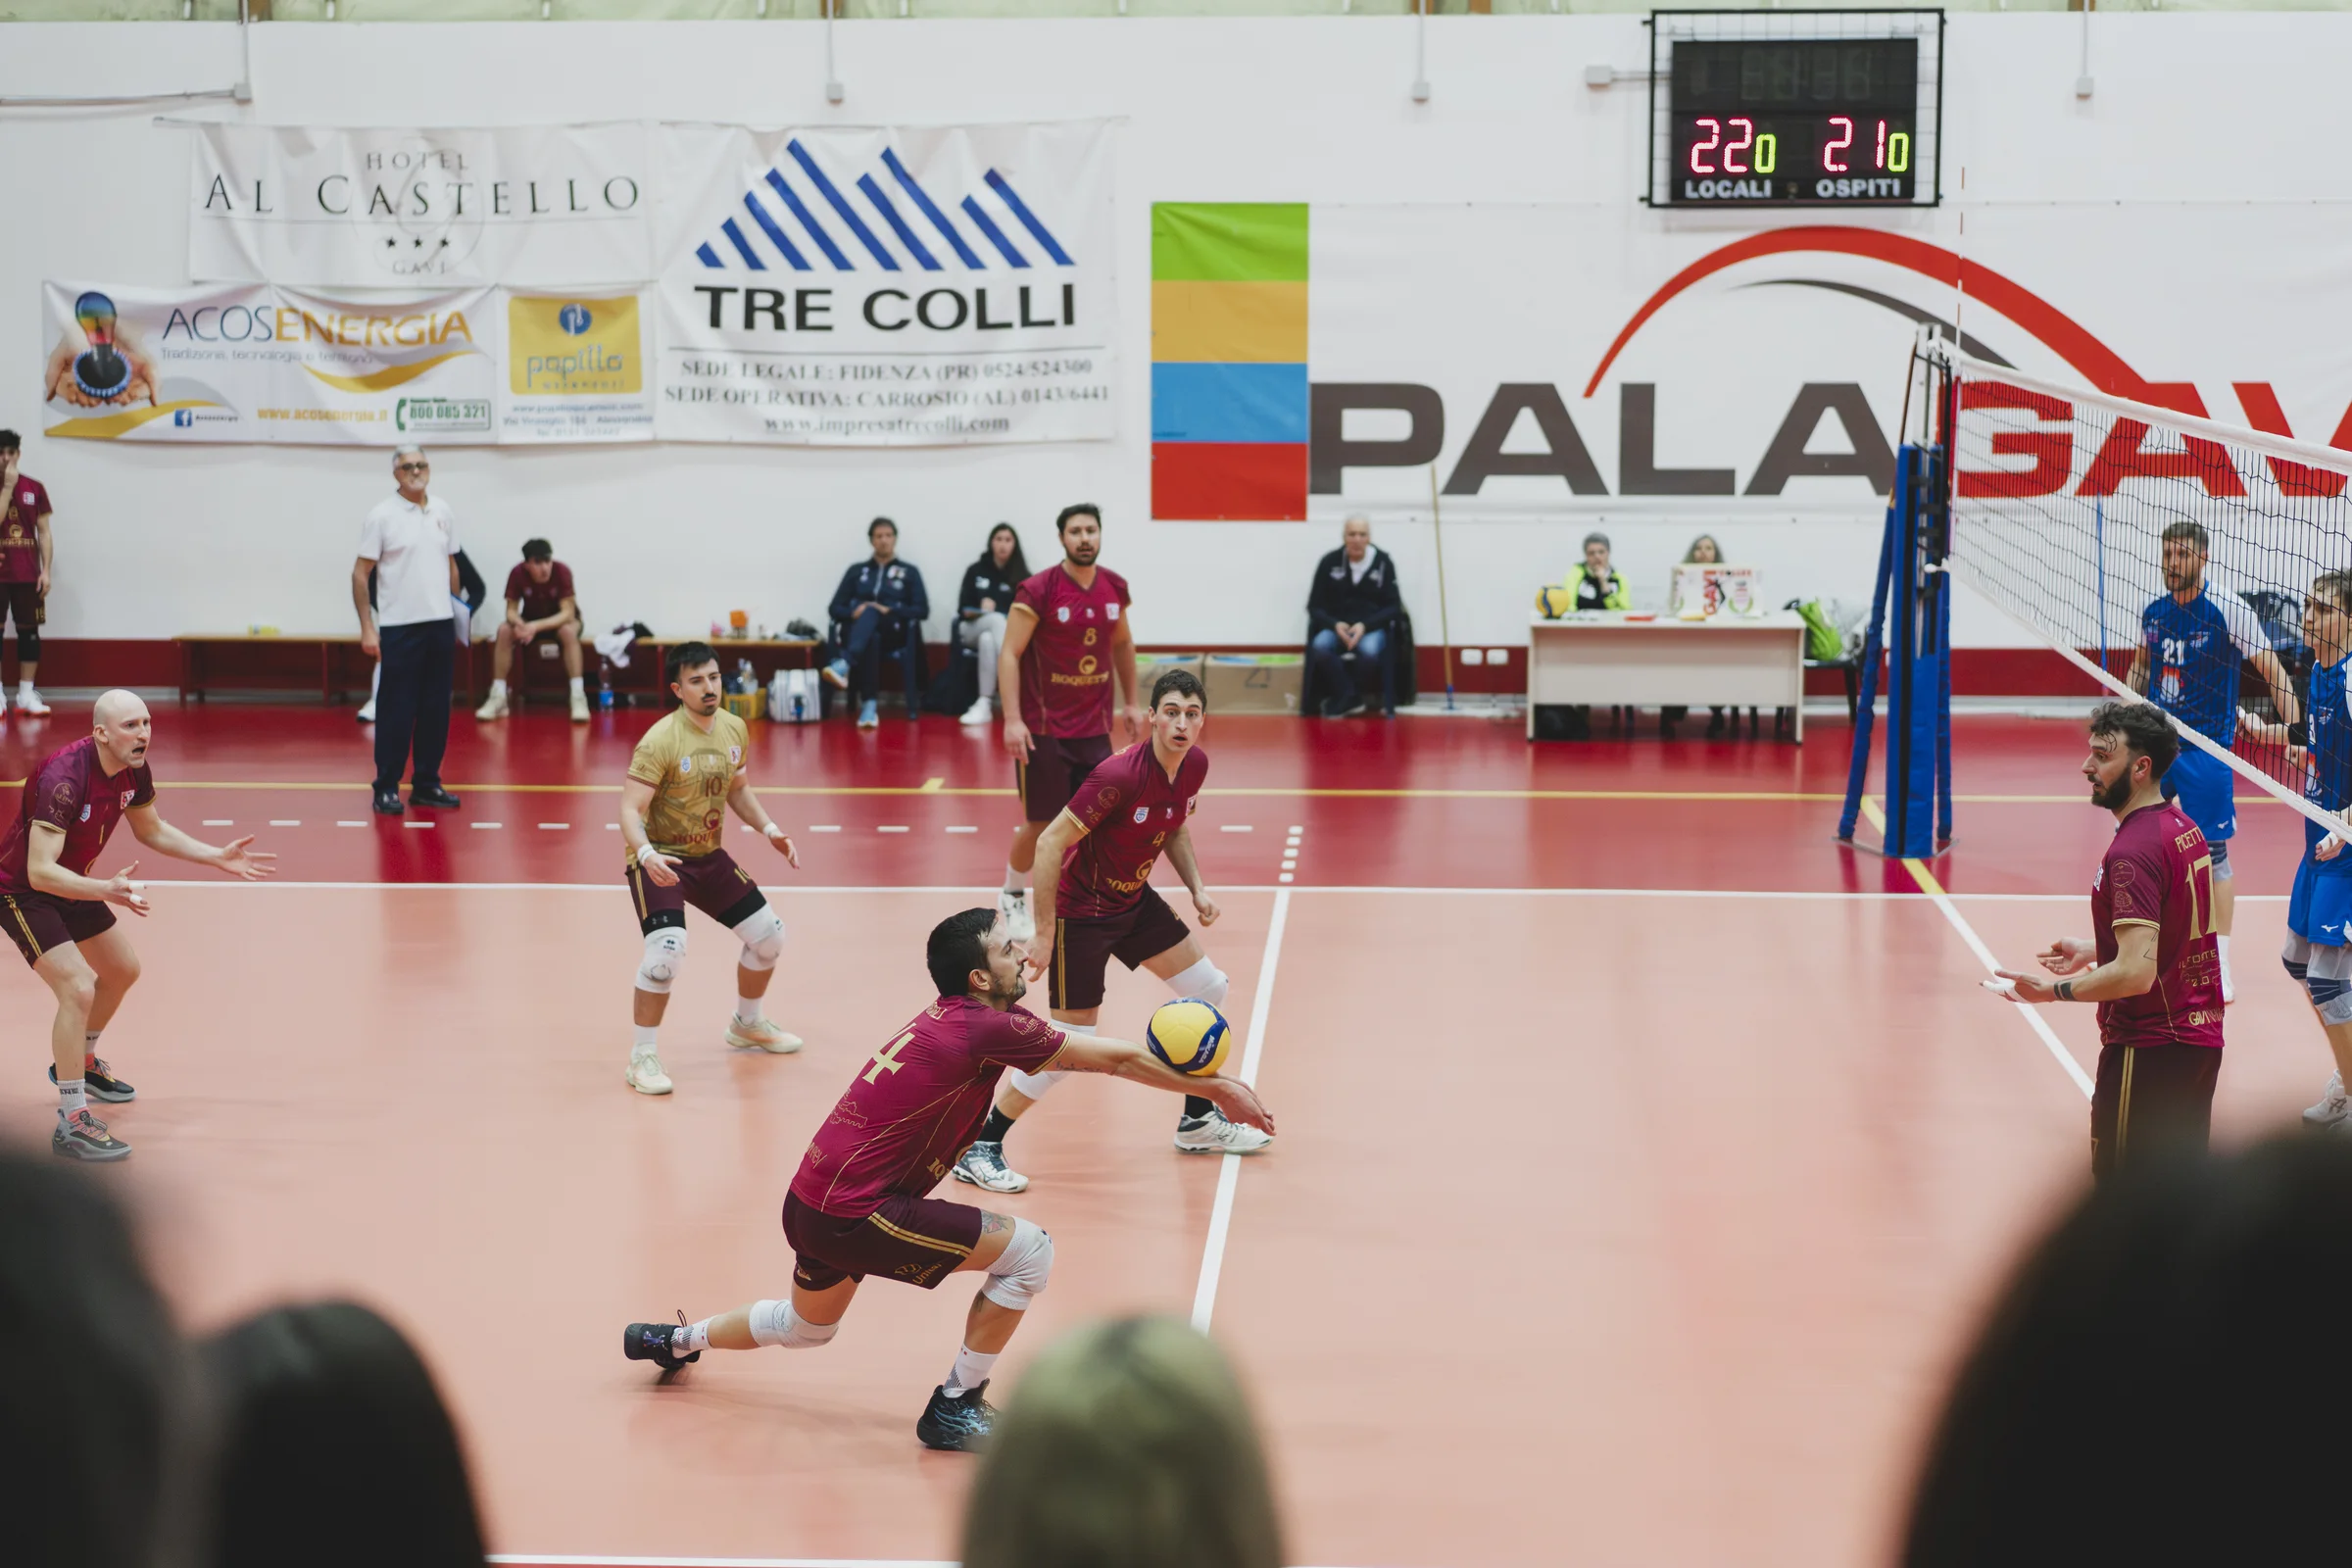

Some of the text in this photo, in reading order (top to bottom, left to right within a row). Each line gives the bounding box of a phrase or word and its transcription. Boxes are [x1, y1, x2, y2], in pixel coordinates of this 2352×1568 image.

[367, 151, 469, 171] HOTEL
[205, 173, 639, 217] AL CASTELLO
[1686, 179, 1901, 198] LOCALI OSPITI
[392, 260, 448, 275] GAVI
[694, 283, 1074, 331] TRE COLLI
[162, 305, 473, 347] ACOSENERGIA
[681, 361, 733, 378] SEDE
[840, 365, 931, 381] FIDENZA
[937, 364, 978, 381] (PR)
[665, 386, 718, 404] SEDE
[857, 389, 968, 408] CARROSIO
[973, 389, 1016, 407] (AL)
[410, 404, 433, 419] 800
[1084, 627, 1097, 646] 8
[2161, 638, 2184, 665] 21
[705, 775, 722, 797] 10
[2185, 855, 2217, 941] 17
[862, 1021, 916, 1085] 4
